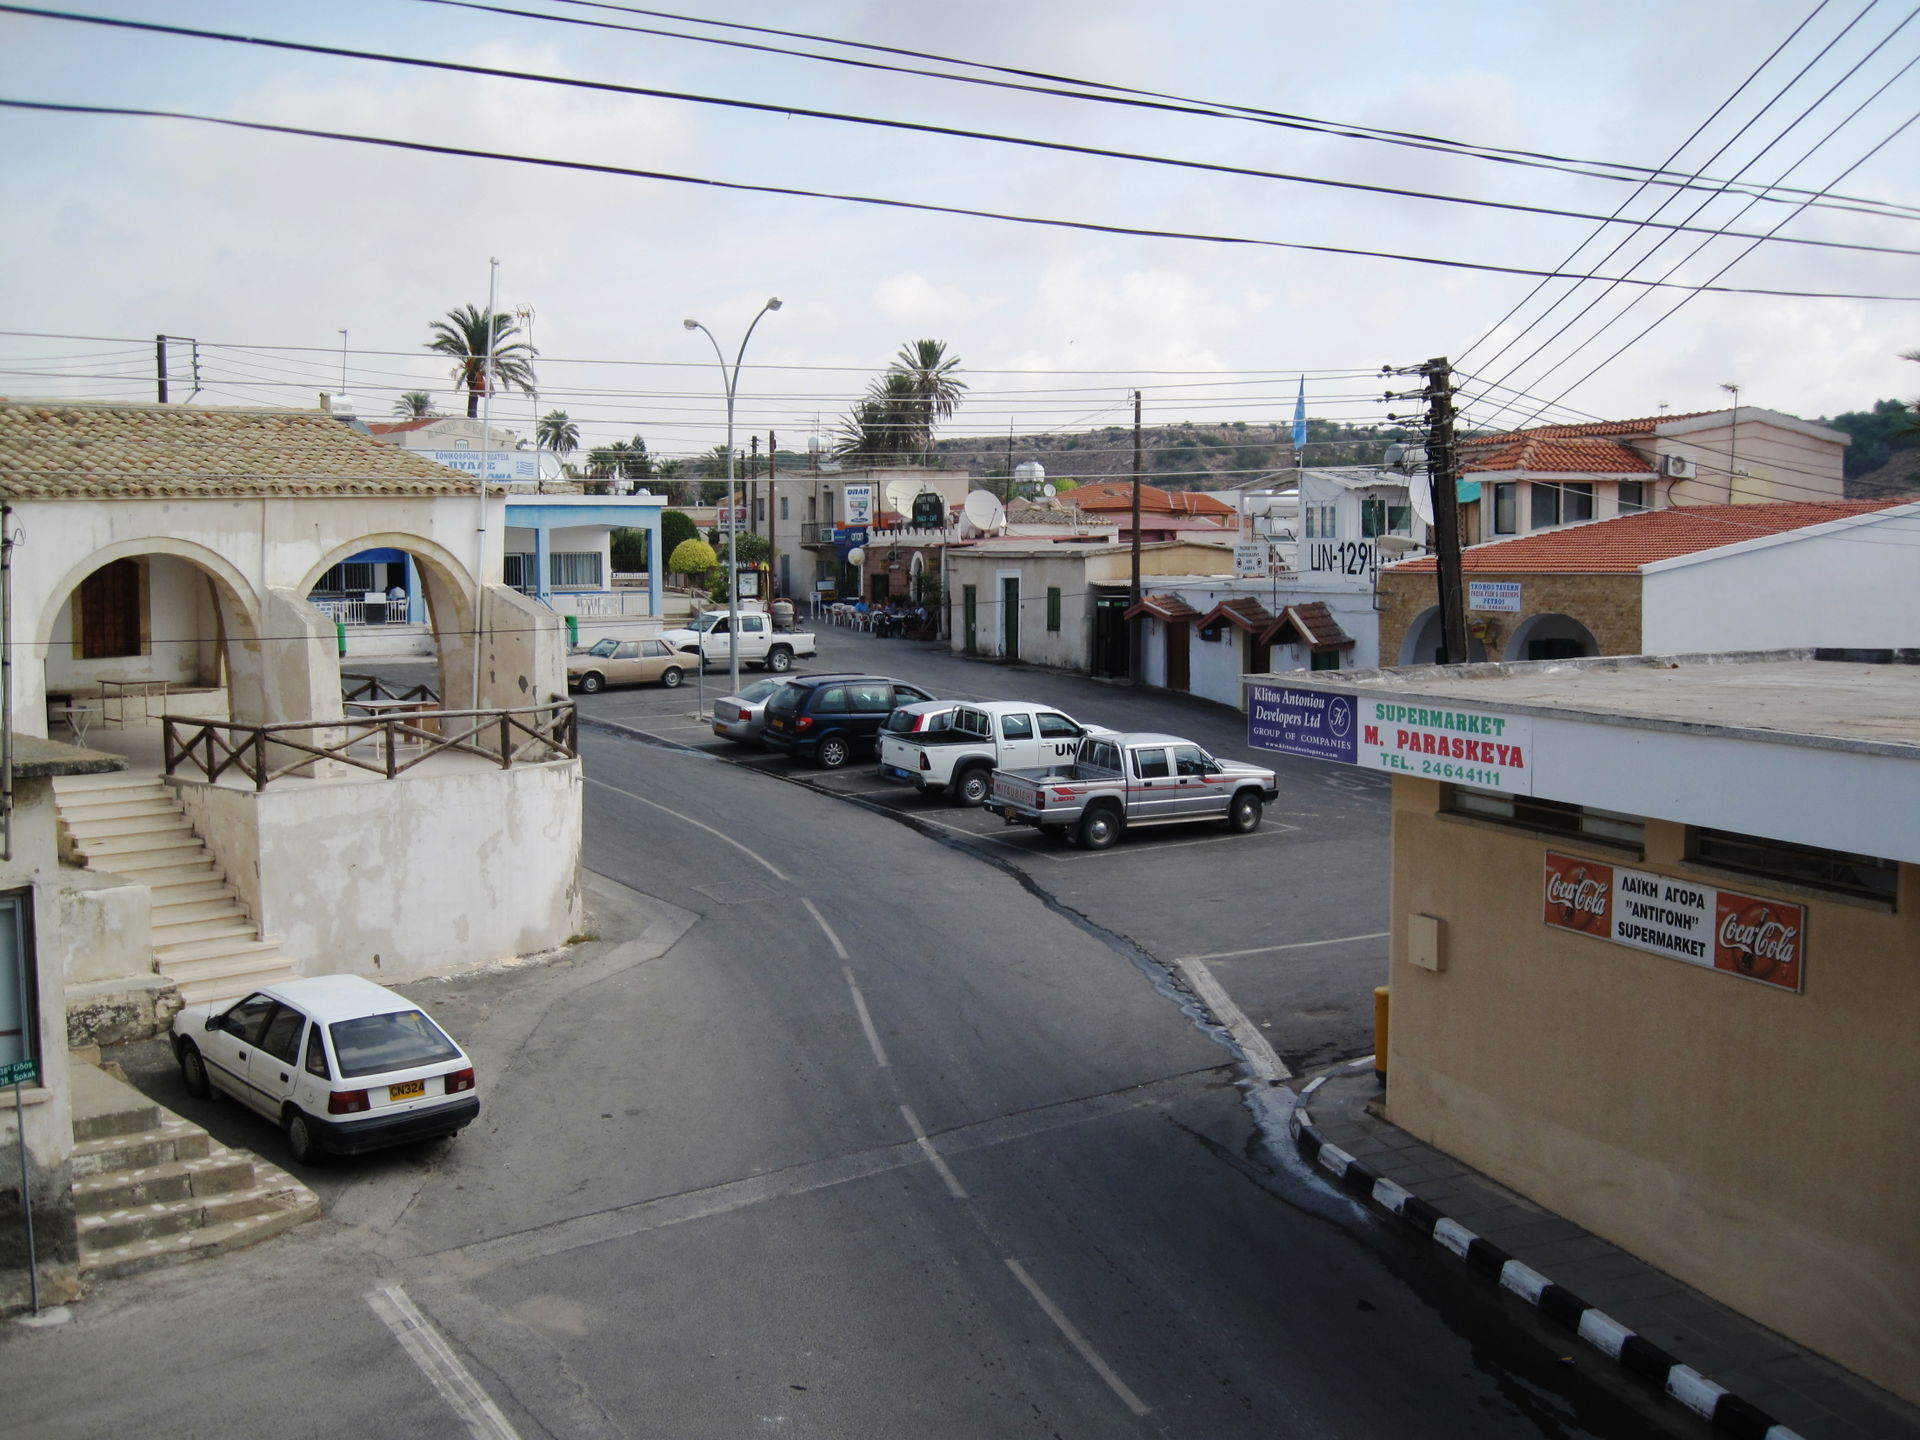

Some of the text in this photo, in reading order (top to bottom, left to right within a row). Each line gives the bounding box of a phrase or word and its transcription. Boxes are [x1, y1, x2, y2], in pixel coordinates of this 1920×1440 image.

[848, 488, 869, 496] ΟΠΑΠ
[1254, 686, 1325, 709] Klitos Antoniou
[1256, 705, 1320, 728] Developers Ltd
[1376, 704, 1505, 736] SUPERMARKET
[1055, 743, 1076, 756] UN
[1254, 727, 1352, 750] GROUP OF COMPANIES
[1364, 725, 1524, 768] M. PARASKEYA
[1380, 752, 1500, 786] TEL. 24644111
[996, 784, 1033, 802] MITSUBISHI
[1547, 872, 1608, 915] Coca-Cola
[1622, 876, 1705, 910] ΛΑΪΚΗ ΑΓΟΡΑ
[1618, 922, 1706, 958] SUPERMARKET
[1719, 913, 1797, 962] Coca-Cola
[14, 1070, 36, 1082] Sokak
[390, 1080, 425, 1097] CN324
